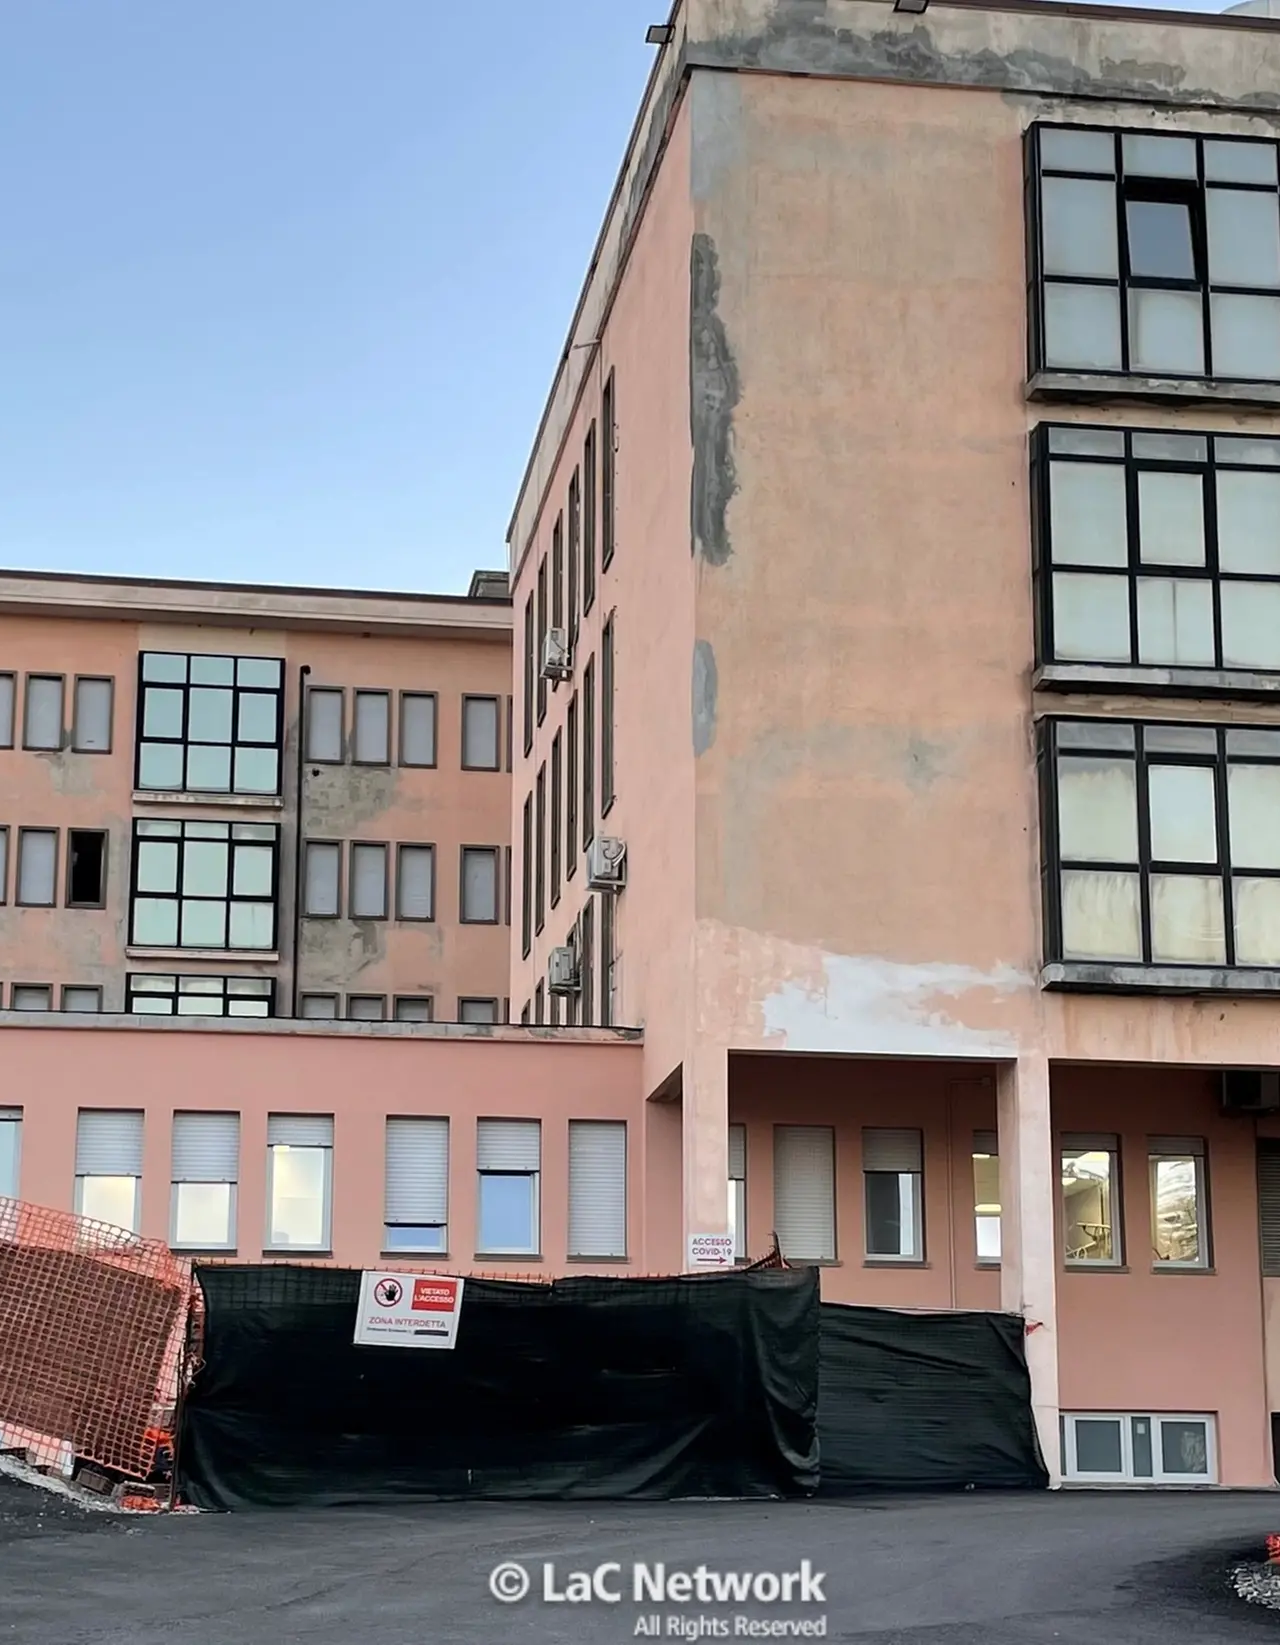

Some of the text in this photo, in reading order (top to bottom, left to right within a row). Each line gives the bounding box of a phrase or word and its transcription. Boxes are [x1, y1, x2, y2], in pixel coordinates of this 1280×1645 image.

[692, 1238, 732, 1246] ACCESSO
[692, 1247, 732, 1256] COVID-19
[420, 1287, 450, 1295] VIETATO
[414, 1295, 454, 1303] L'ACCESSO
[368, 1316, 446, 1328] ZONA INTERDETTA
